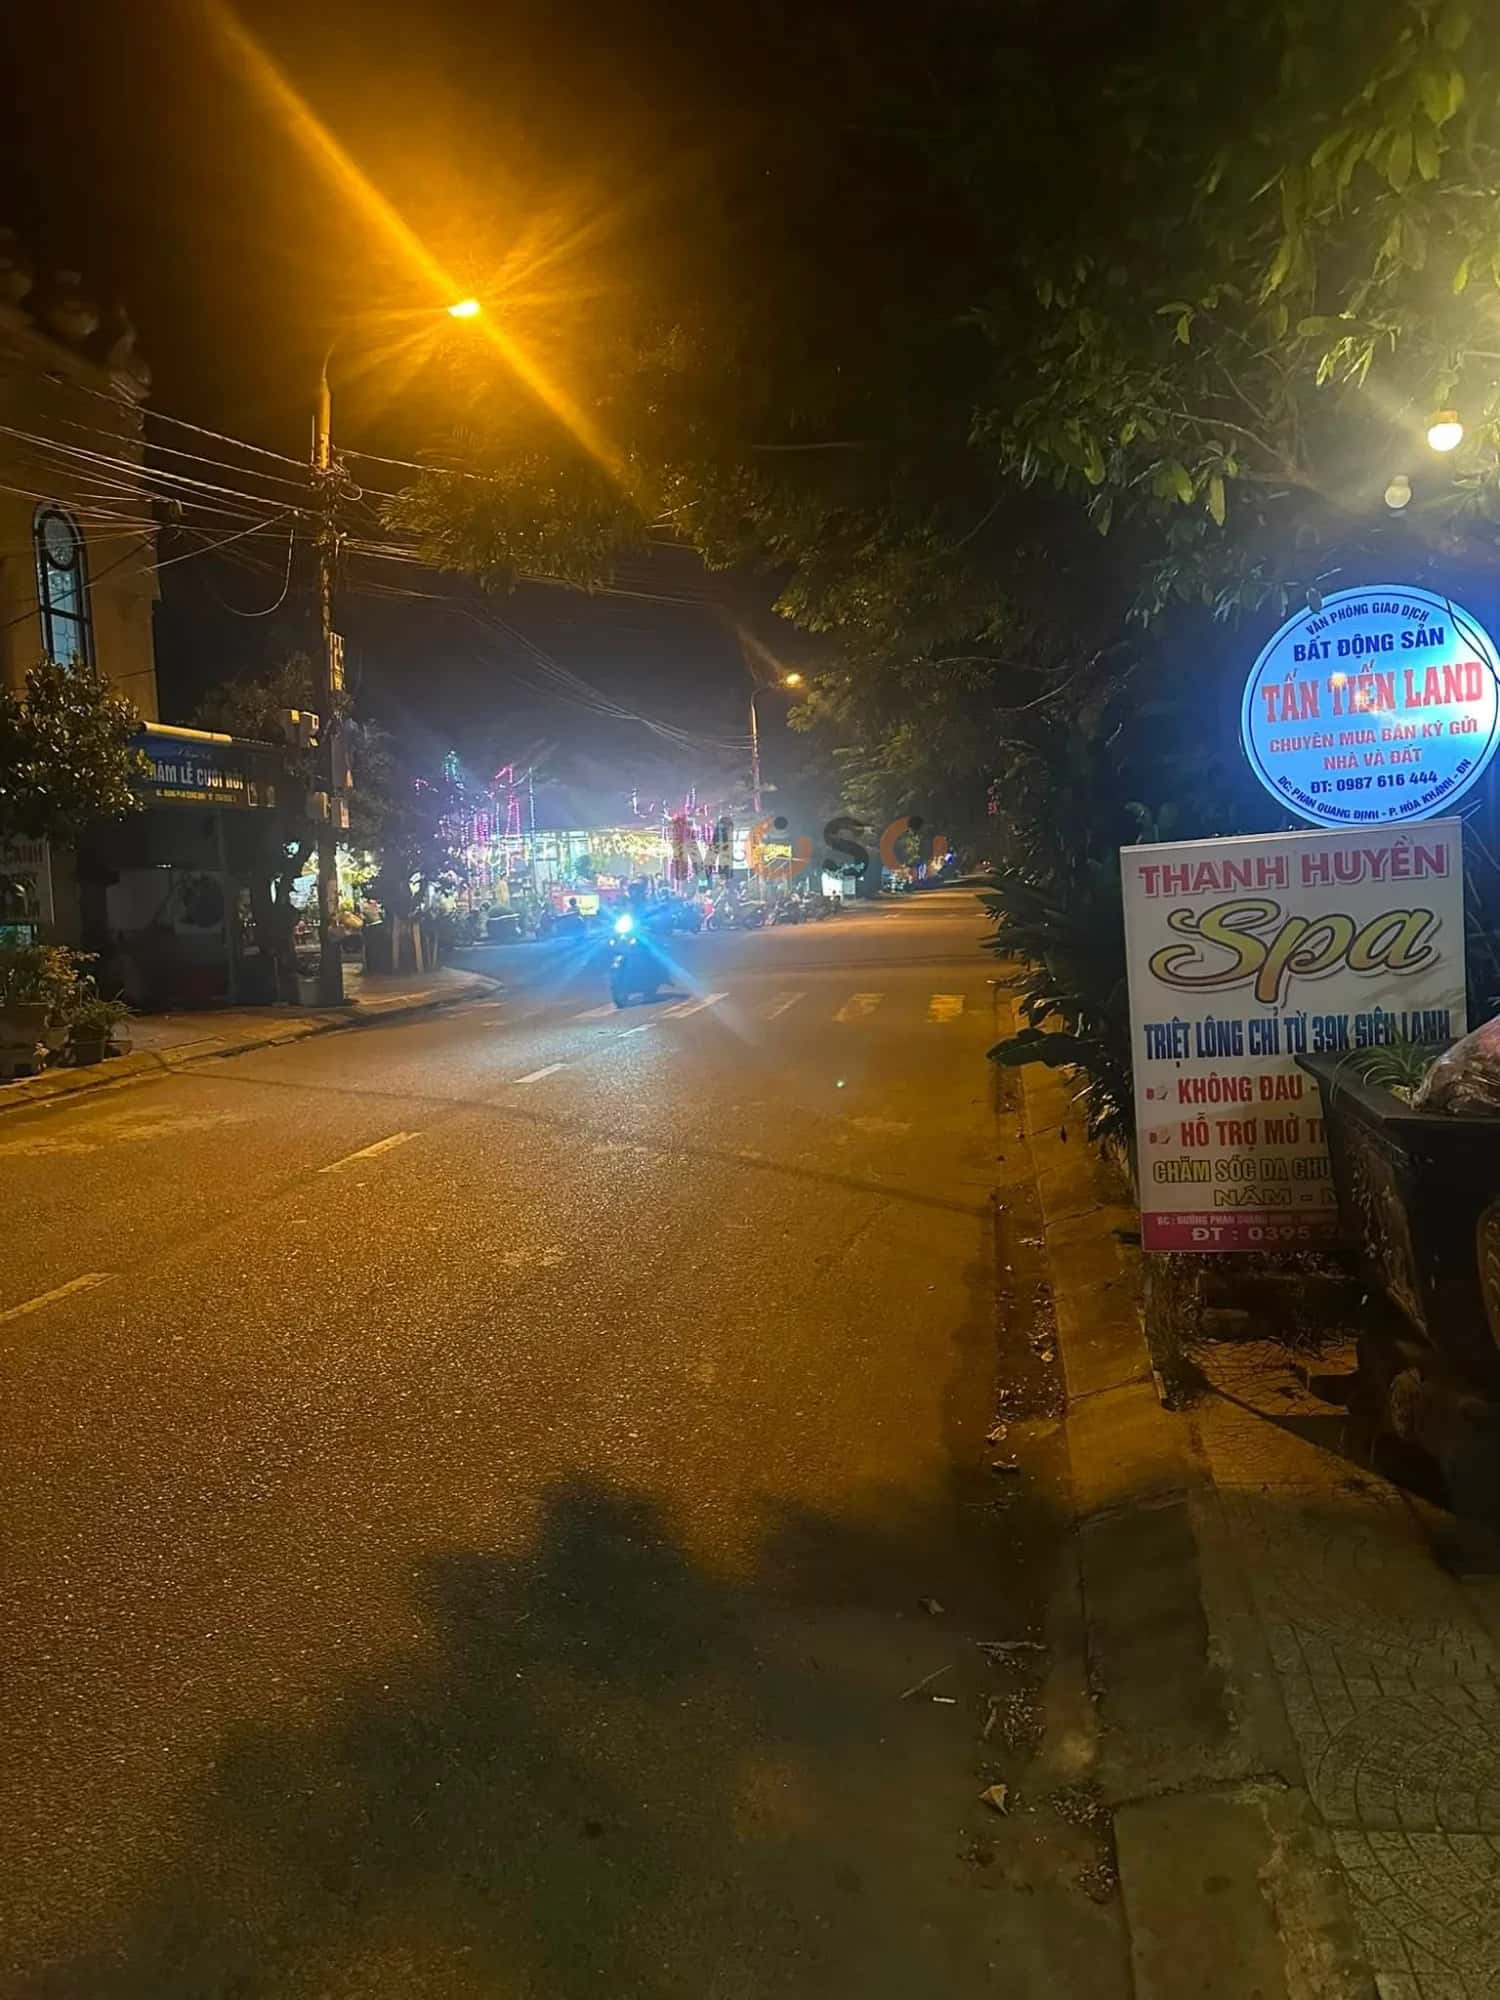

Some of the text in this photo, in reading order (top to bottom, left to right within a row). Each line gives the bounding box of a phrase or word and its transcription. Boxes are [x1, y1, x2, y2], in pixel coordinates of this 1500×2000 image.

[1372, 602, 1400, 614] GIAO
[1401, 604, 1430, 622] DỊCH
[1294, 624, 1445, 661] BẤT ĐỘNG SẢN
[1261, 669, 1320, 723] TẤN
[1404, 662, 1483, 708] LAND
[1270, 731, 1334, 753] CHUYÊN
[1339, 728, 1376, 748] MUA
[1324, 744, 1423, 770] NHÀ VÀ ĐẤT
[1336, 776, 1372, 791] 0987
[1377, 773, 1406, 788] 616
[1409, 770, 1438, 785] 444
[1139, 835, 1448, 895] THANH HUYỀN
[1149, 898, 1437, 1004] Spa
[1144, 1016, 1191, 1068] TRIỆT
[1196, 1015, 1243, 1058] LÔNG
[1248, 1006, 1280, 1055] CHỈ
[1283, 1010, 1308, 1055] TỪ
[1312, 1014, 1349, 1052] 39K
[1177, 1072, 1253, 1104] KHÔNG
[1260, 1072, 1303, 1101] ĐAU
[1180, 1112, 1210, 1147] HỖ
[1216, 1118, 1257, 1152] TRỢ
[1153, 1156, 1212, 1184] CHĂM
[1215, 1154, 1257, 1182] SÓC
[1261, 1158, 1289, 1180] DA
[1192, 1227, 1224, 1241] ĐT
[1247, 1225, 1313, 1241] 0395
